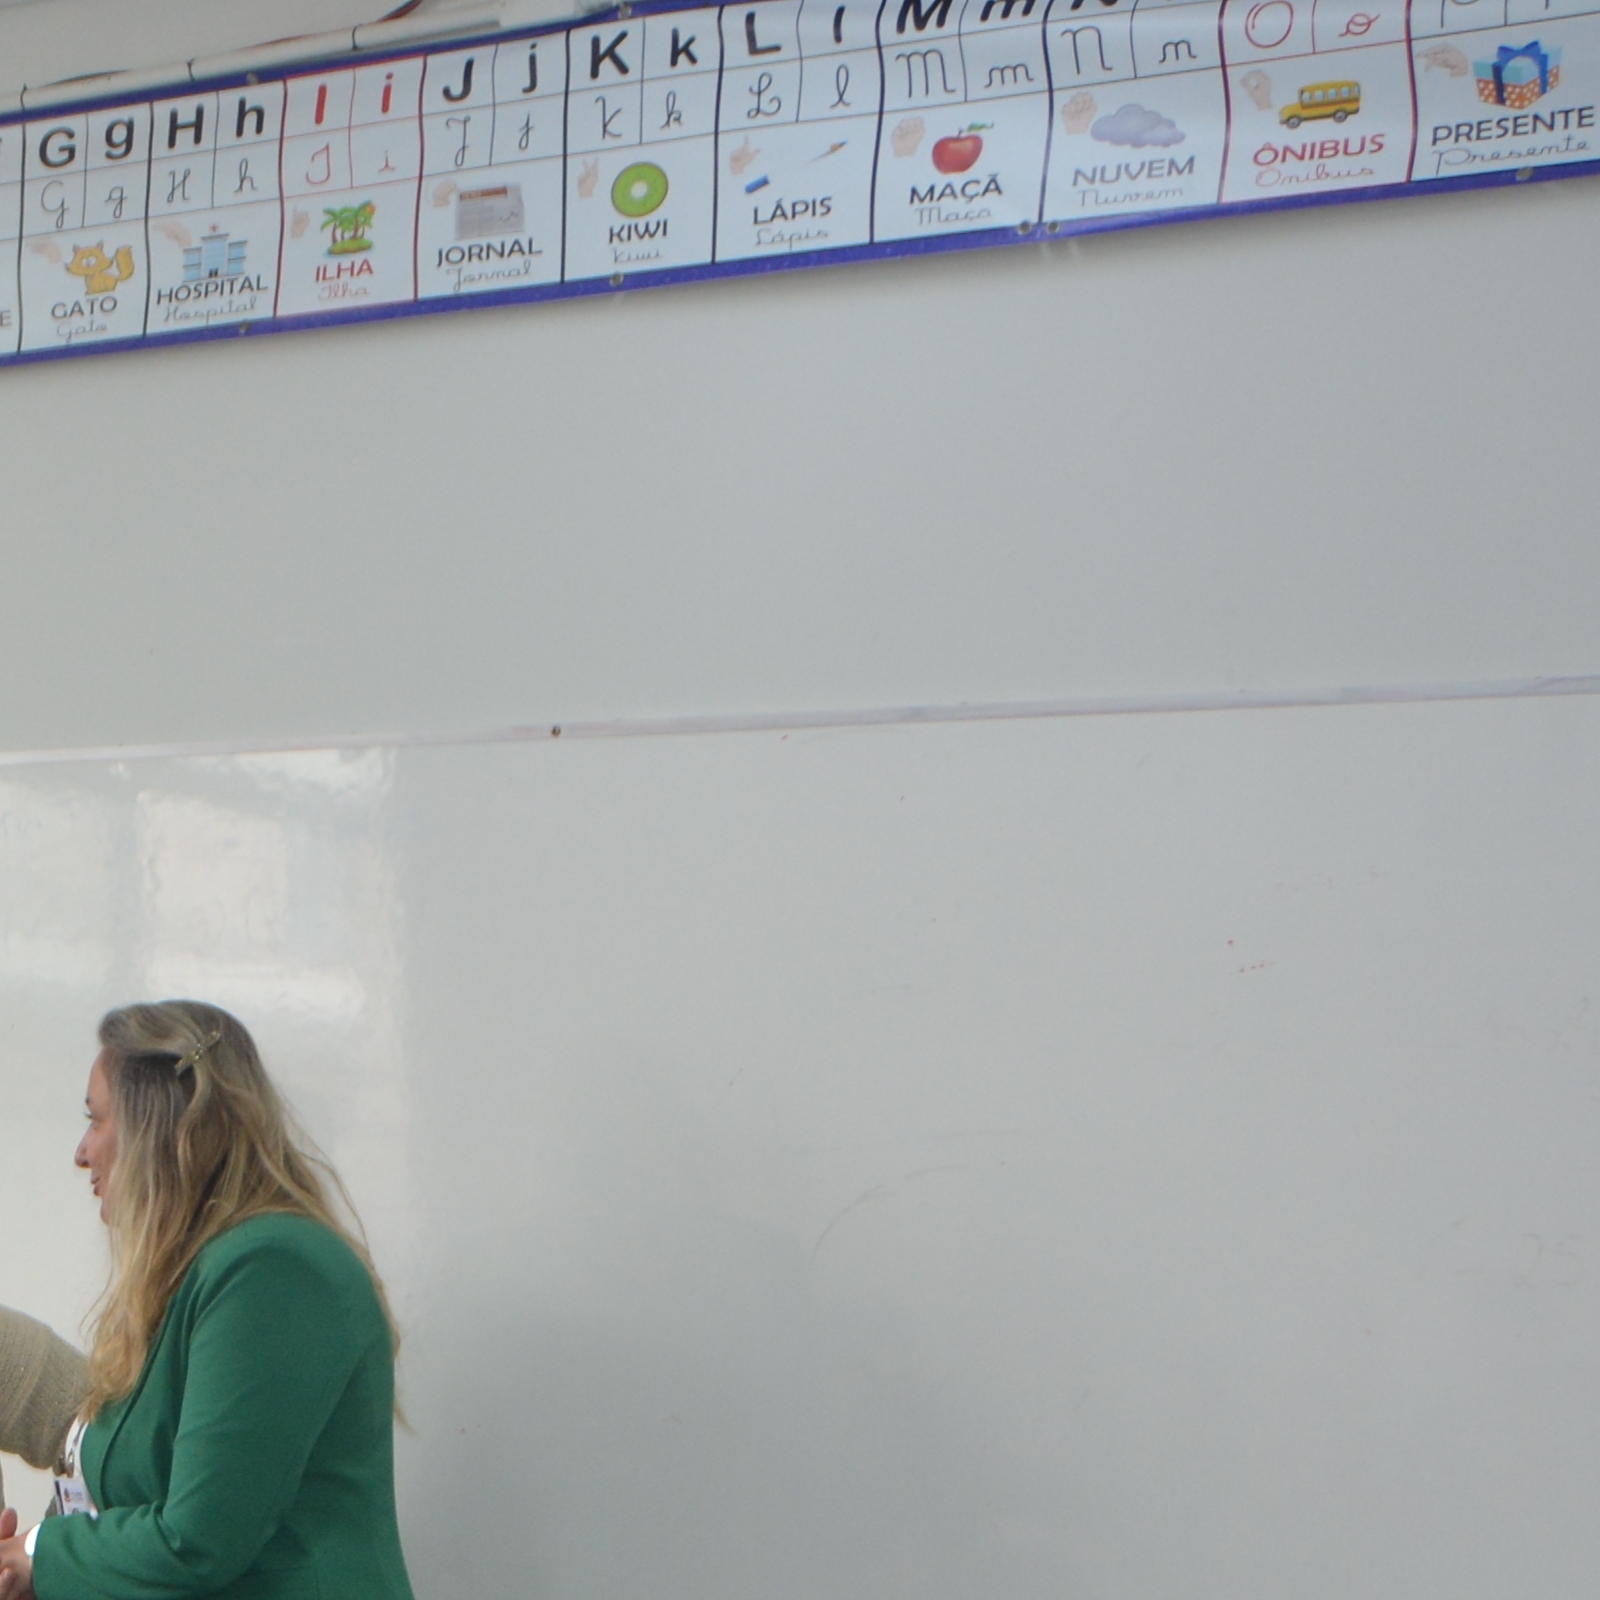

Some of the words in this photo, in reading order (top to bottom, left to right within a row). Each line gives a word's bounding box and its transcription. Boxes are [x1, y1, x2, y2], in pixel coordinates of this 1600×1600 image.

[746, 12, 781, 55] L
[834, 7, 844, 43] l
[590, 30, 629, 80] K
[670, 28, 698, 66] k
[442, 59, 474, 102] J
[522, 43, 537, 94] j
[315, 84, 327, 124] I
[381, 72, 393, 113] i
[168, 105, 204, 148] H
[236, 98, 264, 137] h
[1431, 106, 1595, 146] PRESENTE
[39, 128, 76, 168] G
[105, 117, 134, 159] g
[1252, 134, 1385, 167] ÔNIBUS
[1072, 156, 1196, 187] NUVEM
[909, 174, 1003, 205] MAÇÃ
[753, 196, 833, 225] LÁPIS
[608, 219, 668, 244] KIWI
[436, 238, 543, 268] JORNAL
[315, 258, 374, 282] ILHA
[156, 273, 268, 305] HOSPITAL
[51, 296, 118, 319] GATO
